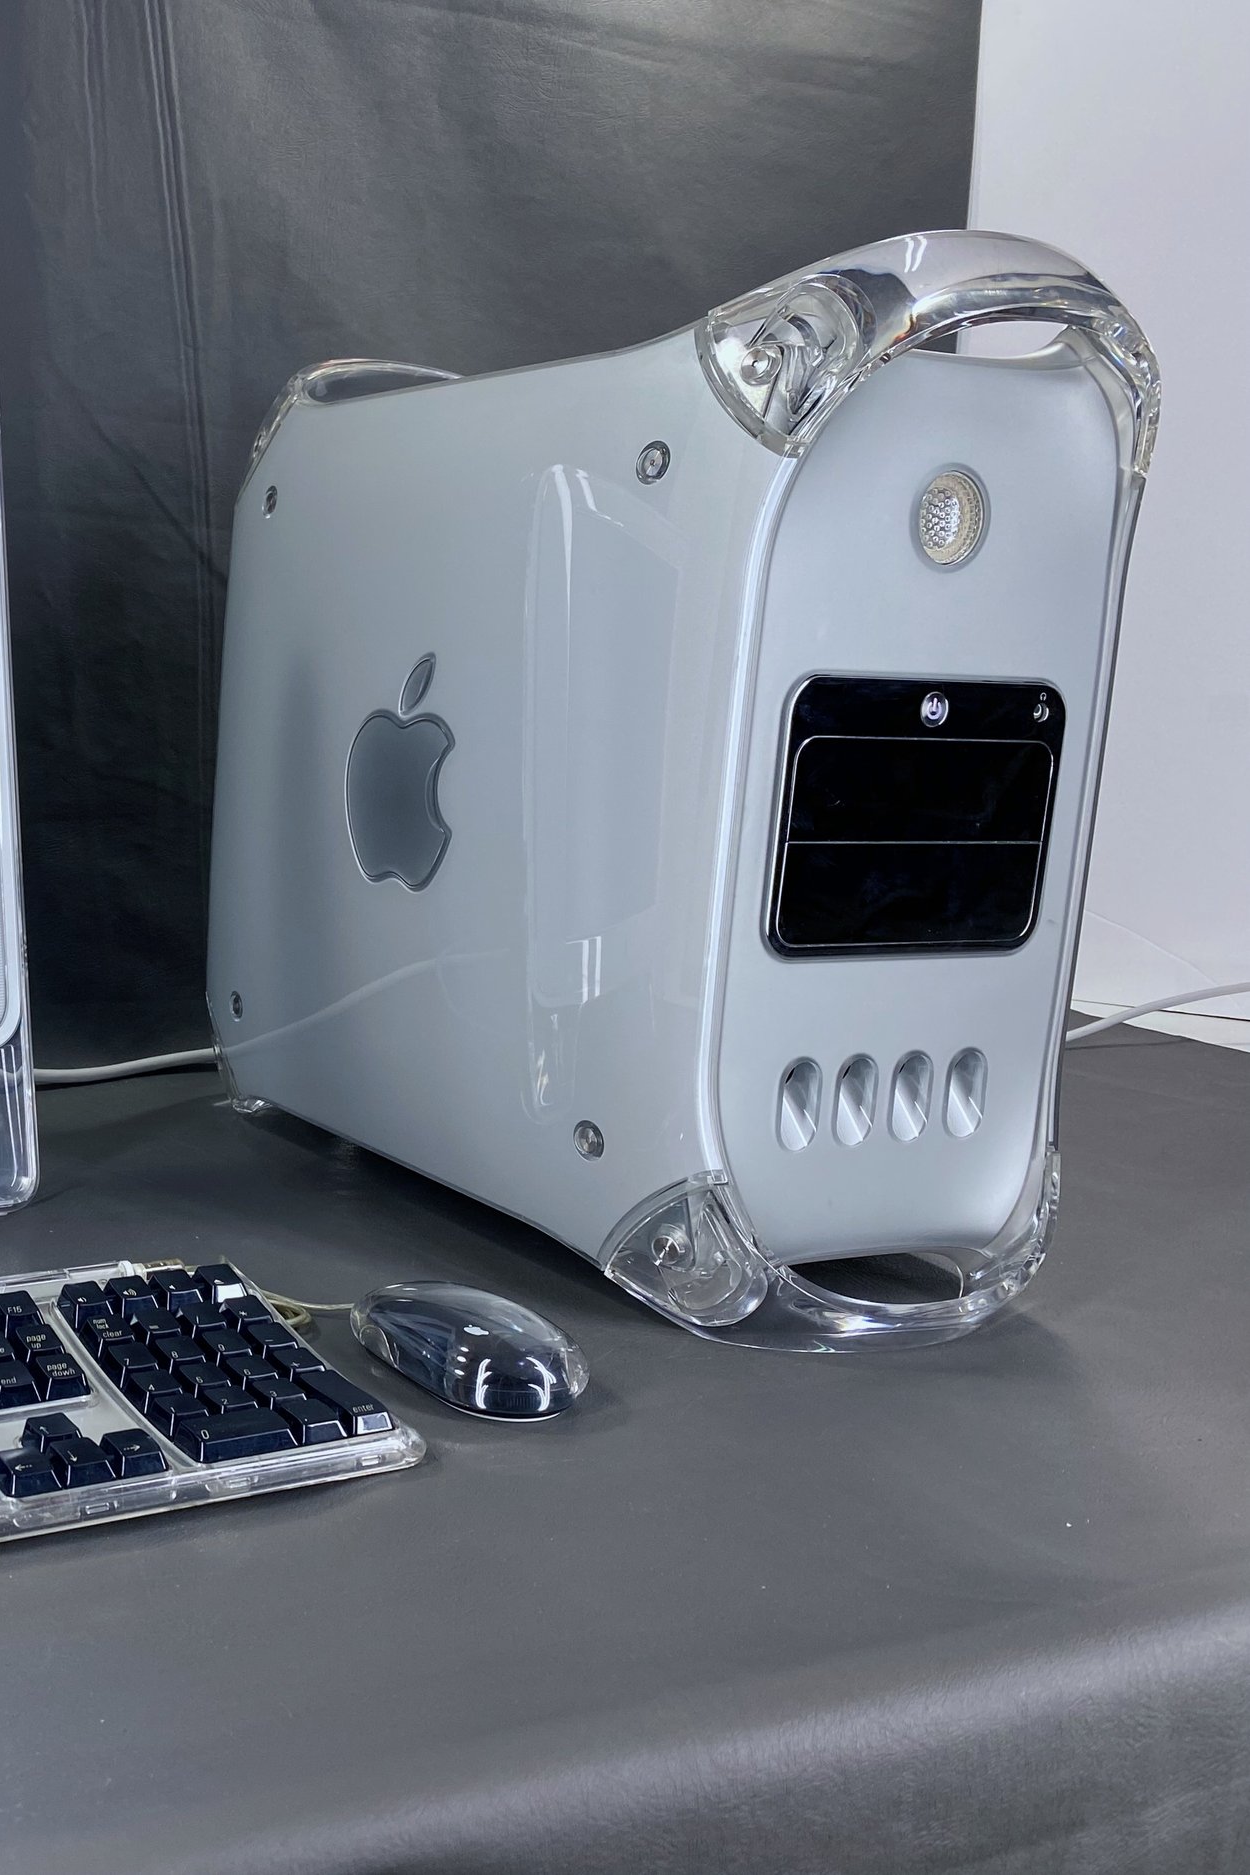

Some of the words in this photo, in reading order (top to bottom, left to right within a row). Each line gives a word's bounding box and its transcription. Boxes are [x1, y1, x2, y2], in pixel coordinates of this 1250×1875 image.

[8, 1306, 22, 1314] F15
[26, 1334, 46, 1342] page
[103, 1330, 122, 1338] clear
[47, 1362, 67, 1371] page
[53, 1368, 76, 1376] down
[1, 1376, 17, 1385] end
[353, 1403, 375, 1412] enter
